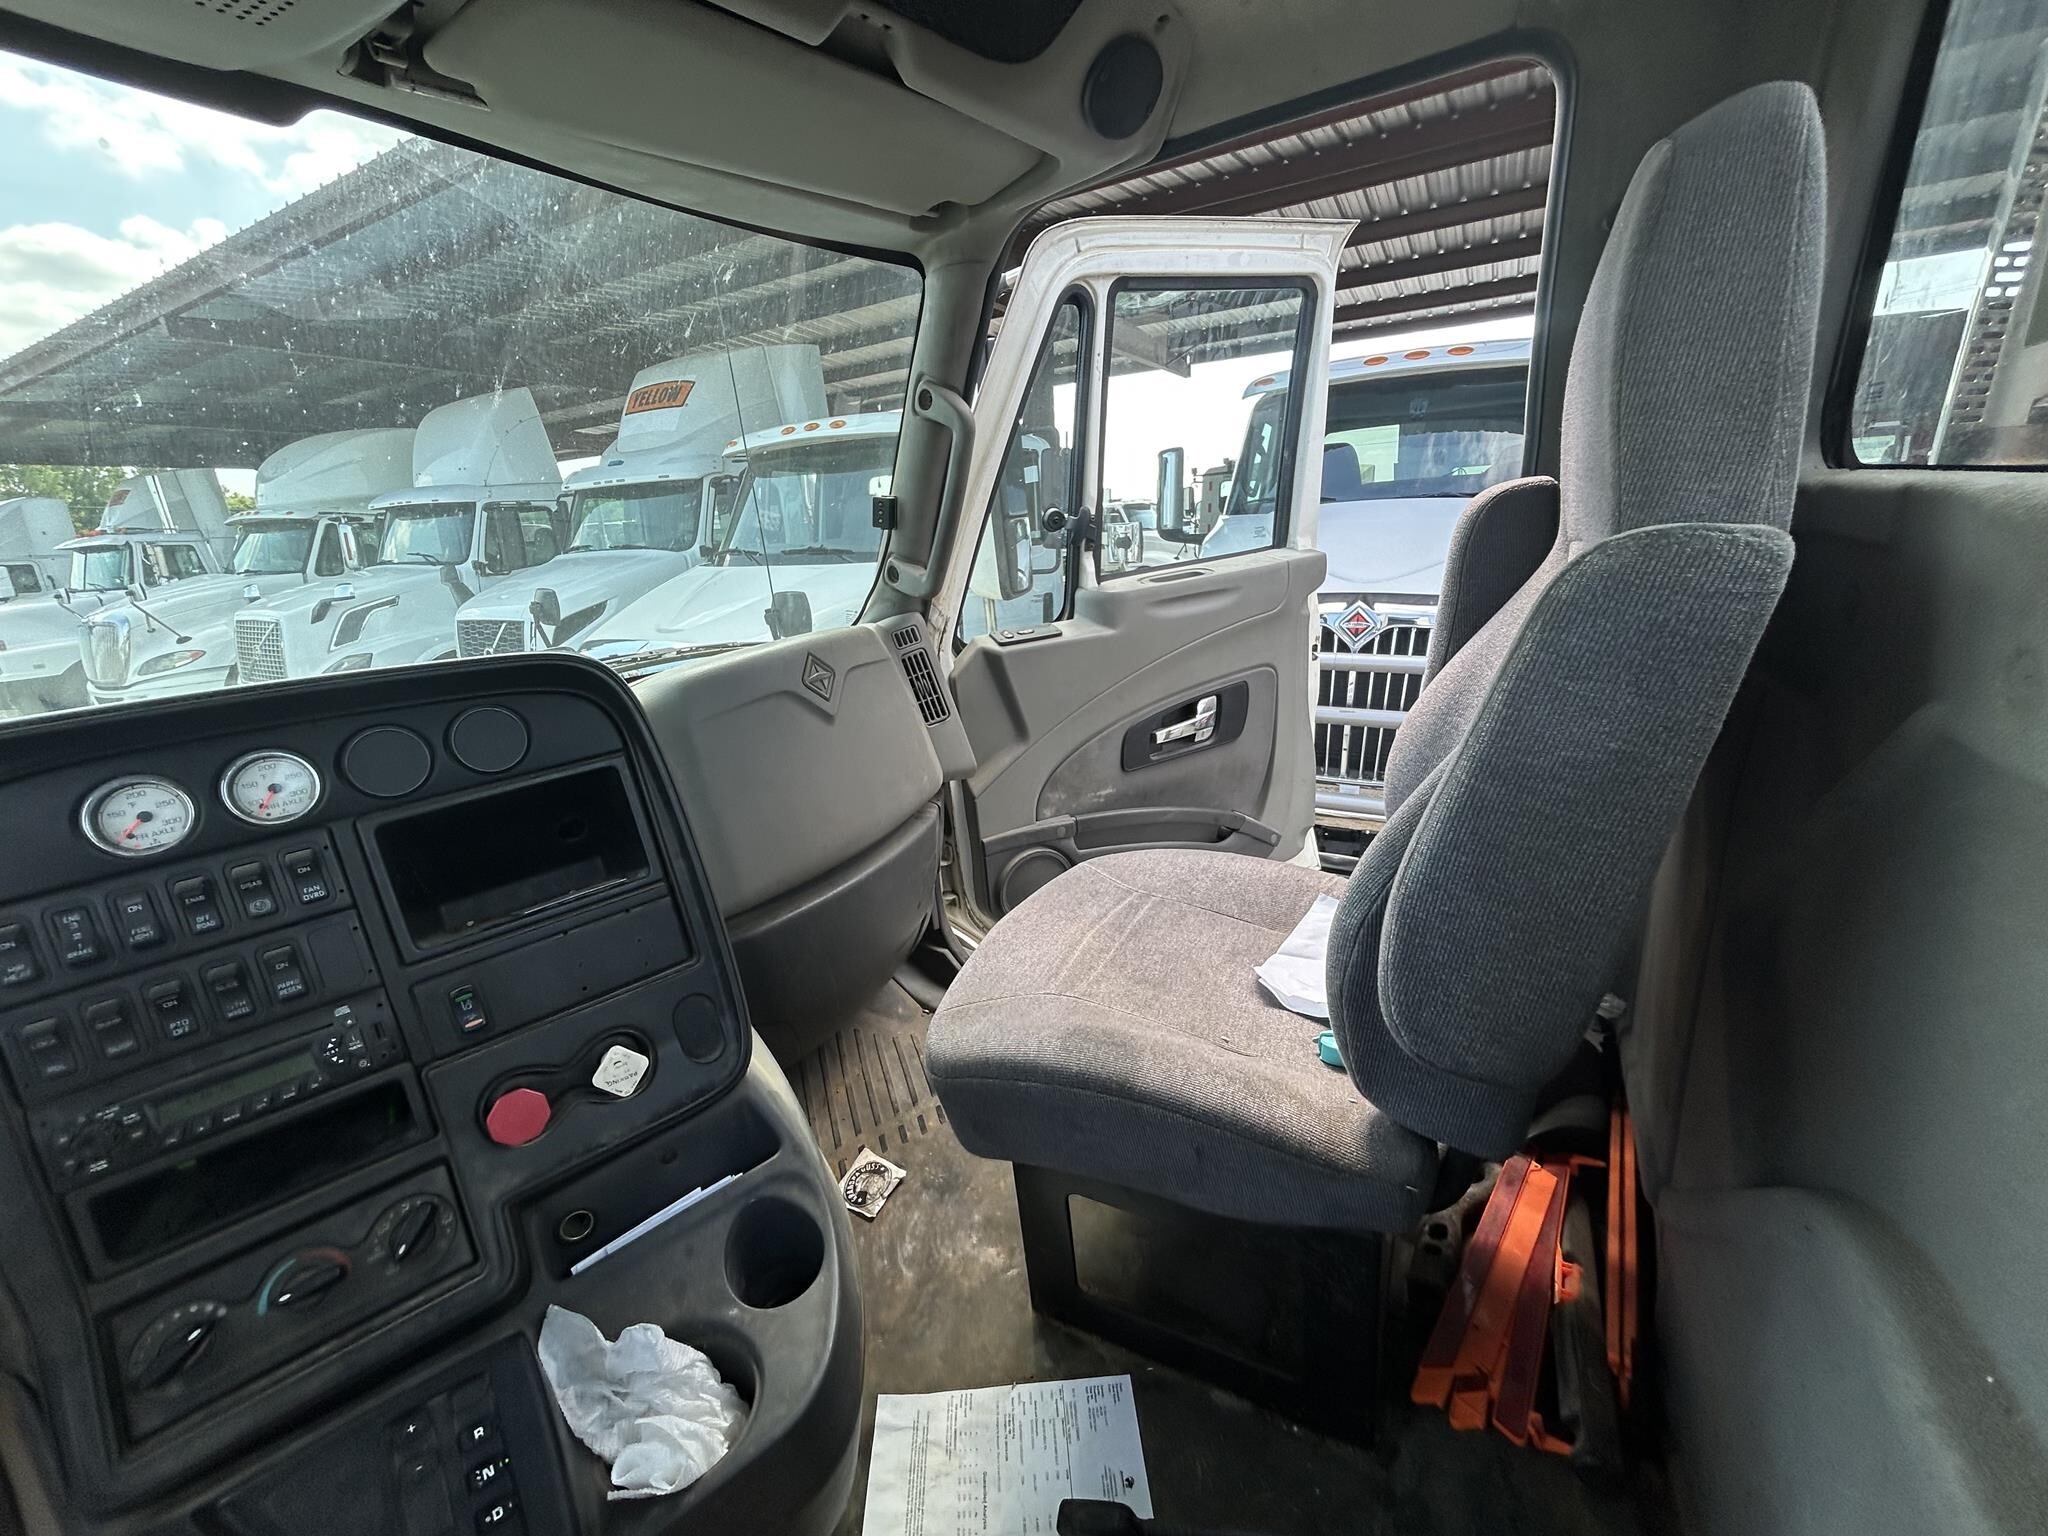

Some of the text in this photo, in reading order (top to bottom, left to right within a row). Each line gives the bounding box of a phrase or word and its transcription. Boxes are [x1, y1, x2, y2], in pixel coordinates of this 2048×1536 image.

[632, 384, 681, 408] YELLOW
[257, 763, 276, 772] 200
[284, 771, 303, 780] 250
[241, 781, 258, 789] 150
[125, 790, 146, 800] 200
[289, 788, 308, 797] 300
[154, 798, 176, 808] 250
[106, 810, 126, 818] 150
[162, 816, 182, 826] 300
[152, 827, 174, 837] AXLE
[297, 865, 311, 873] ON
[303, 884, 320, 893] FAN
[303, 890, 325, 901] OVRD
[127, 904, 142, 912] ON
[473, 1426, 484, 1439] R
[481, 1464, 495, 1480] N
[491, 1506, 504, 1521] D
